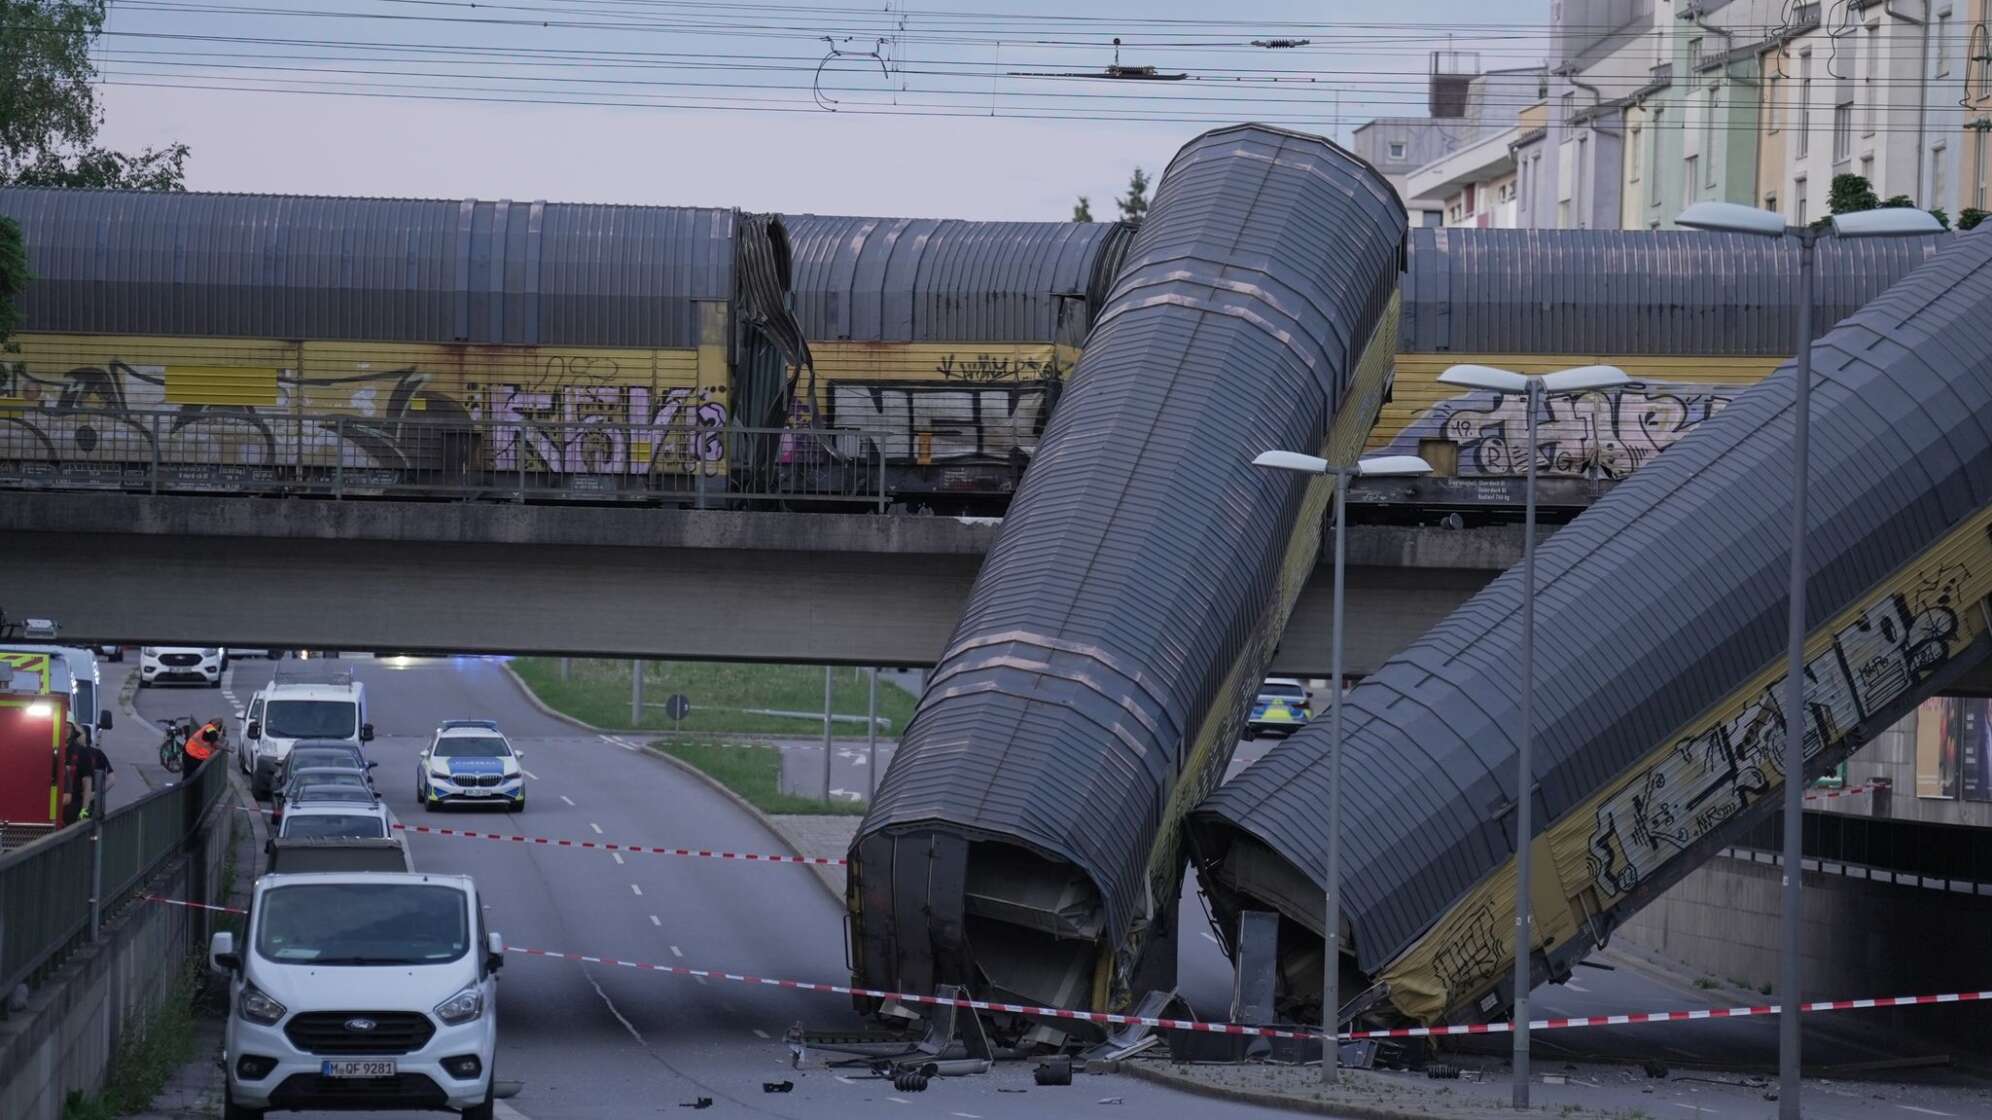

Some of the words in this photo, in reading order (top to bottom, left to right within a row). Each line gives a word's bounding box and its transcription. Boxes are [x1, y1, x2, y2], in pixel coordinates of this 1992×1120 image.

[330, 1063, 339, 1074] M
[346, 1063, 361, 1075] QF
[363, 1063, 393, 1074] 9281
